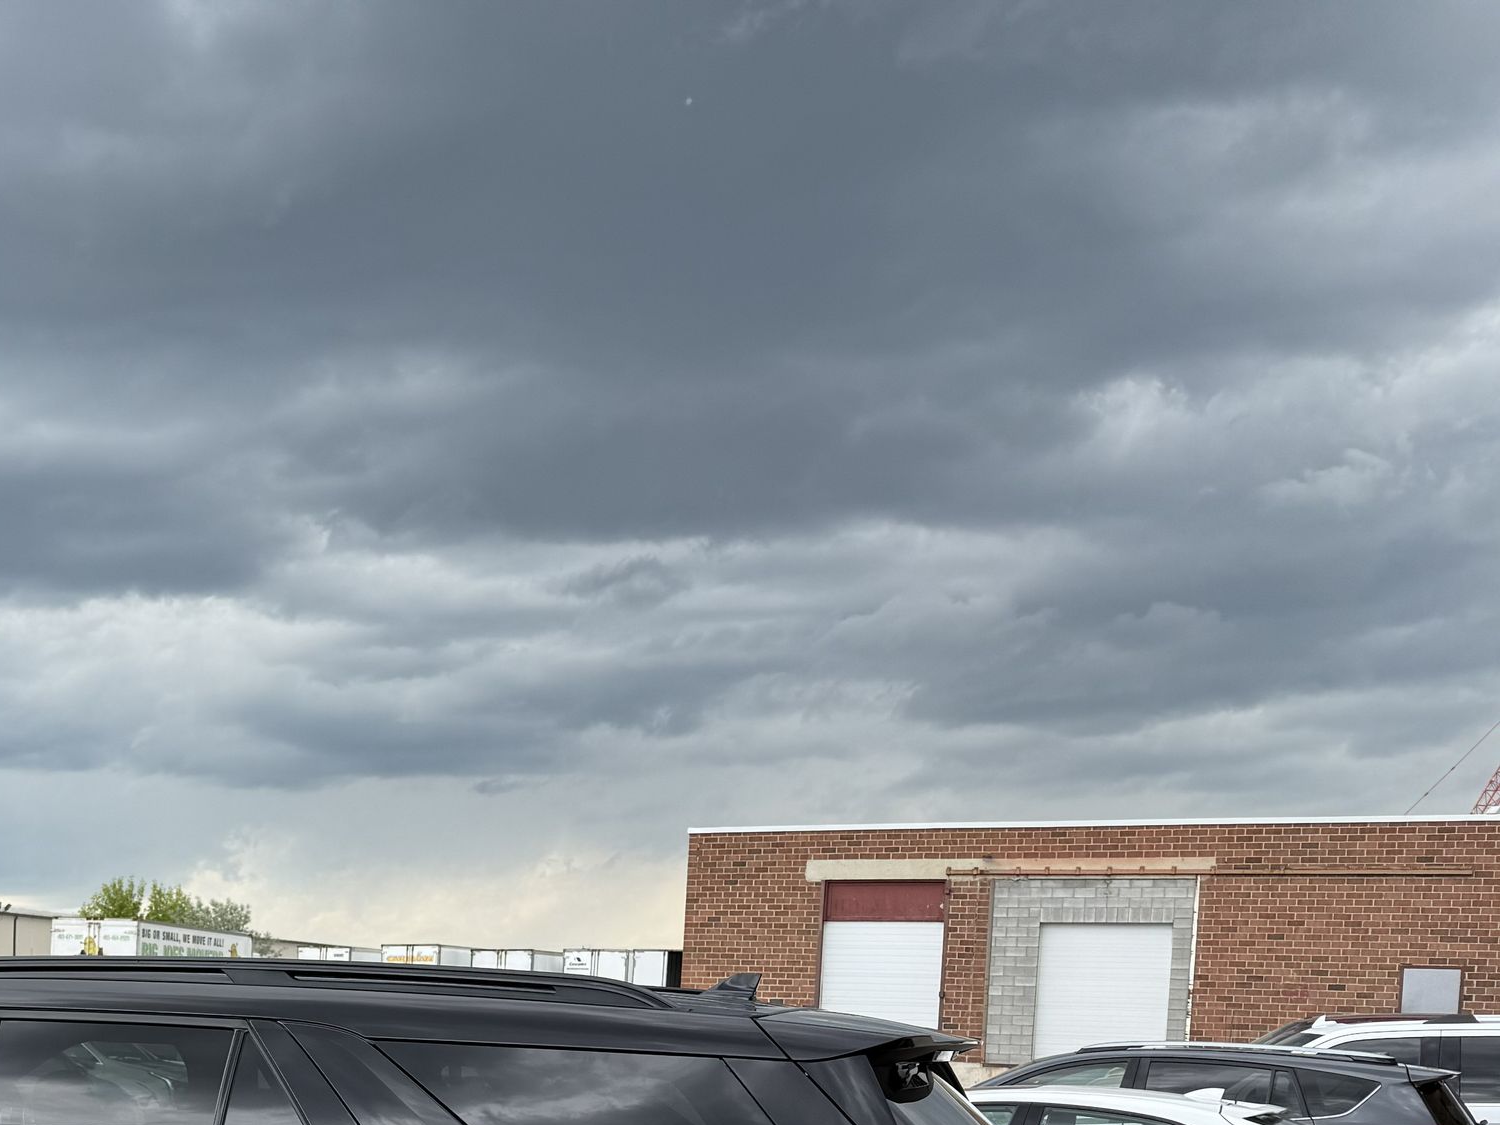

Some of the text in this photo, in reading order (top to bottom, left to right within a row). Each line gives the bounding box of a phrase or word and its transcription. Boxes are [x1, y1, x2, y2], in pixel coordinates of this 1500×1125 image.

[142, 928, 152, 938] BIG
[153, 929, 160, 939] OR
[162, 931, 181, 944] SMALL,
[183, 933, 190, 943] WE
[192, 935, 206, 946] MOVE
[207, 936, 212, 946] IT
[214, 938, 224, 947] ALL!
